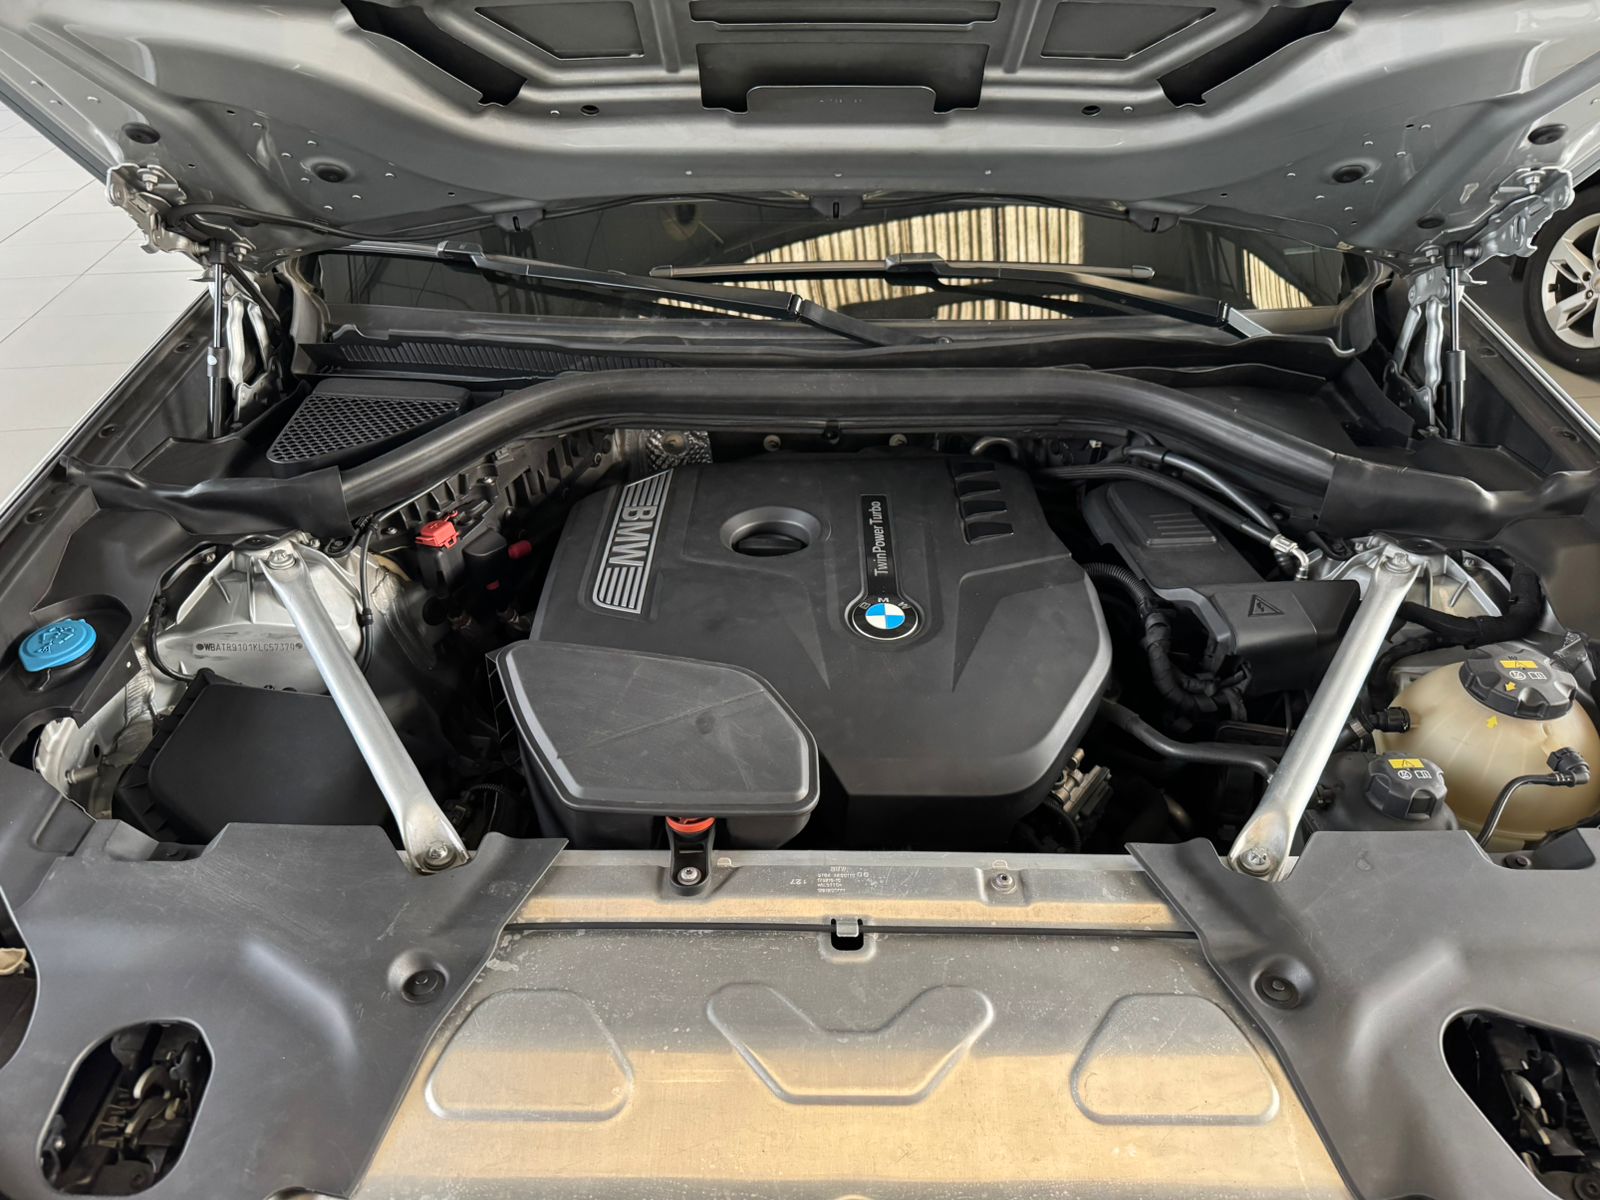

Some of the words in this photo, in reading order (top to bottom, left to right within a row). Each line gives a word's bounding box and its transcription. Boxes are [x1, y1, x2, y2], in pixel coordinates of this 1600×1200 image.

[869, 500, 883, 525] Turbo
[608, 505, 658, 567] BMW
[872, 525, 888, 577] TwinPower
[859, 597, 912, 610] BMW
